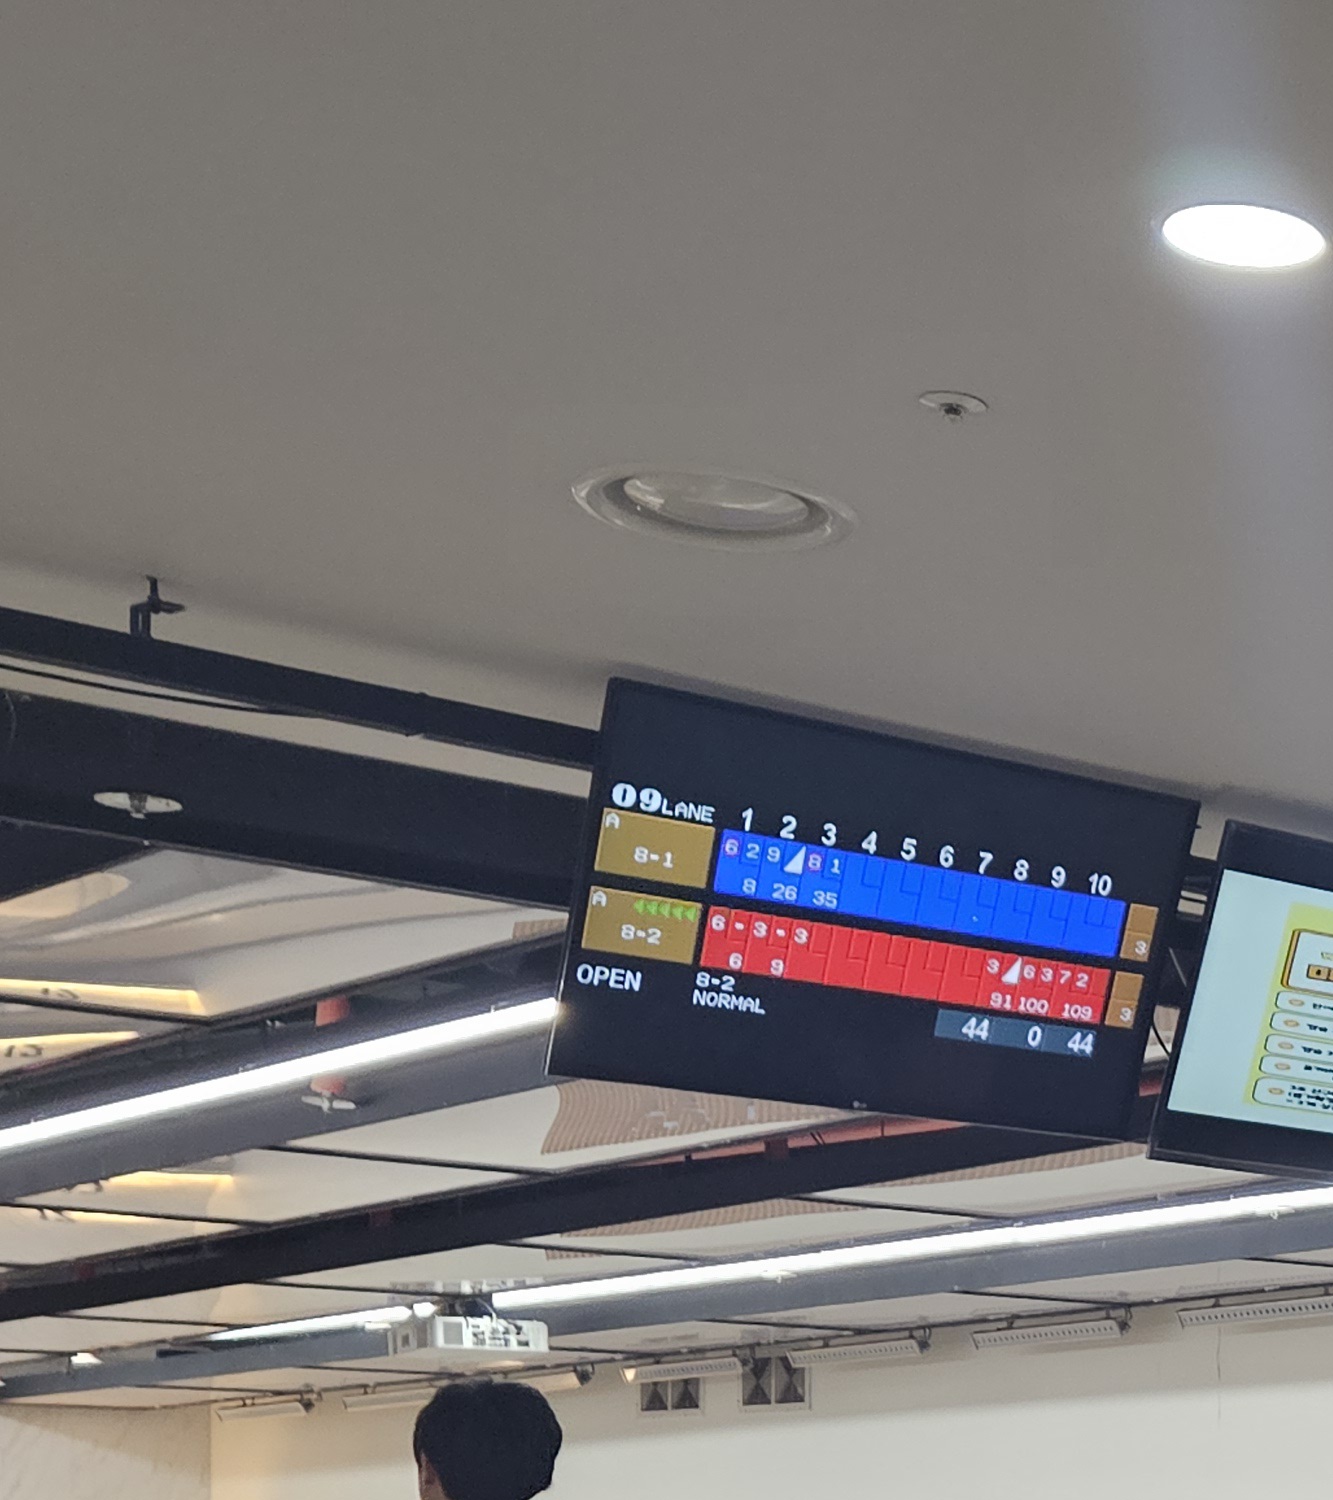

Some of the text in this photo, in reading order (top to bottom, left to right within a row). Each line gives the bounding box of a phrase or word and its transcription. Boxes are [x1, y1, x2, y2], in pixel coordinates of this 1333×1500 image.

[605, 813, 620, 829] A
[725, 840, 840, 874] 6 2 9 8 1
[742, 808, 753, 830] 1
[779, 816, 797, 839] 2
[821, 823, 837, 845] 3
[862, 831, 877, 854] 4
[901, 838, 917, 860] 5
[940, 846, 954, 868] 6
[978, 852, 993, 874] 7
[1014, 859, 1029, 881] 8
[1051, 866, 1066, 888] 9
[1089, 873, 1112, 896] 10
[592, 891, 606, 906] A
[743, 879, 837, 908] 8 26 35
[1135, 940, 1147, 955] 3
[576, 964, 641, 991] OPEN
[1024, 964, 1035, 979] 6
[1060, 971, 1072, 984] 7
[1076, 973, 1088, 987] 2
[693, 990, 765, 1015] NORMAL
[990, 992, 1011, 1009] 91
[1019, 997, 1049, 1014] 100
[1062, 1004, 1092, 1020] 109
[962, 1017, 1094, 1054] 44 0 44
